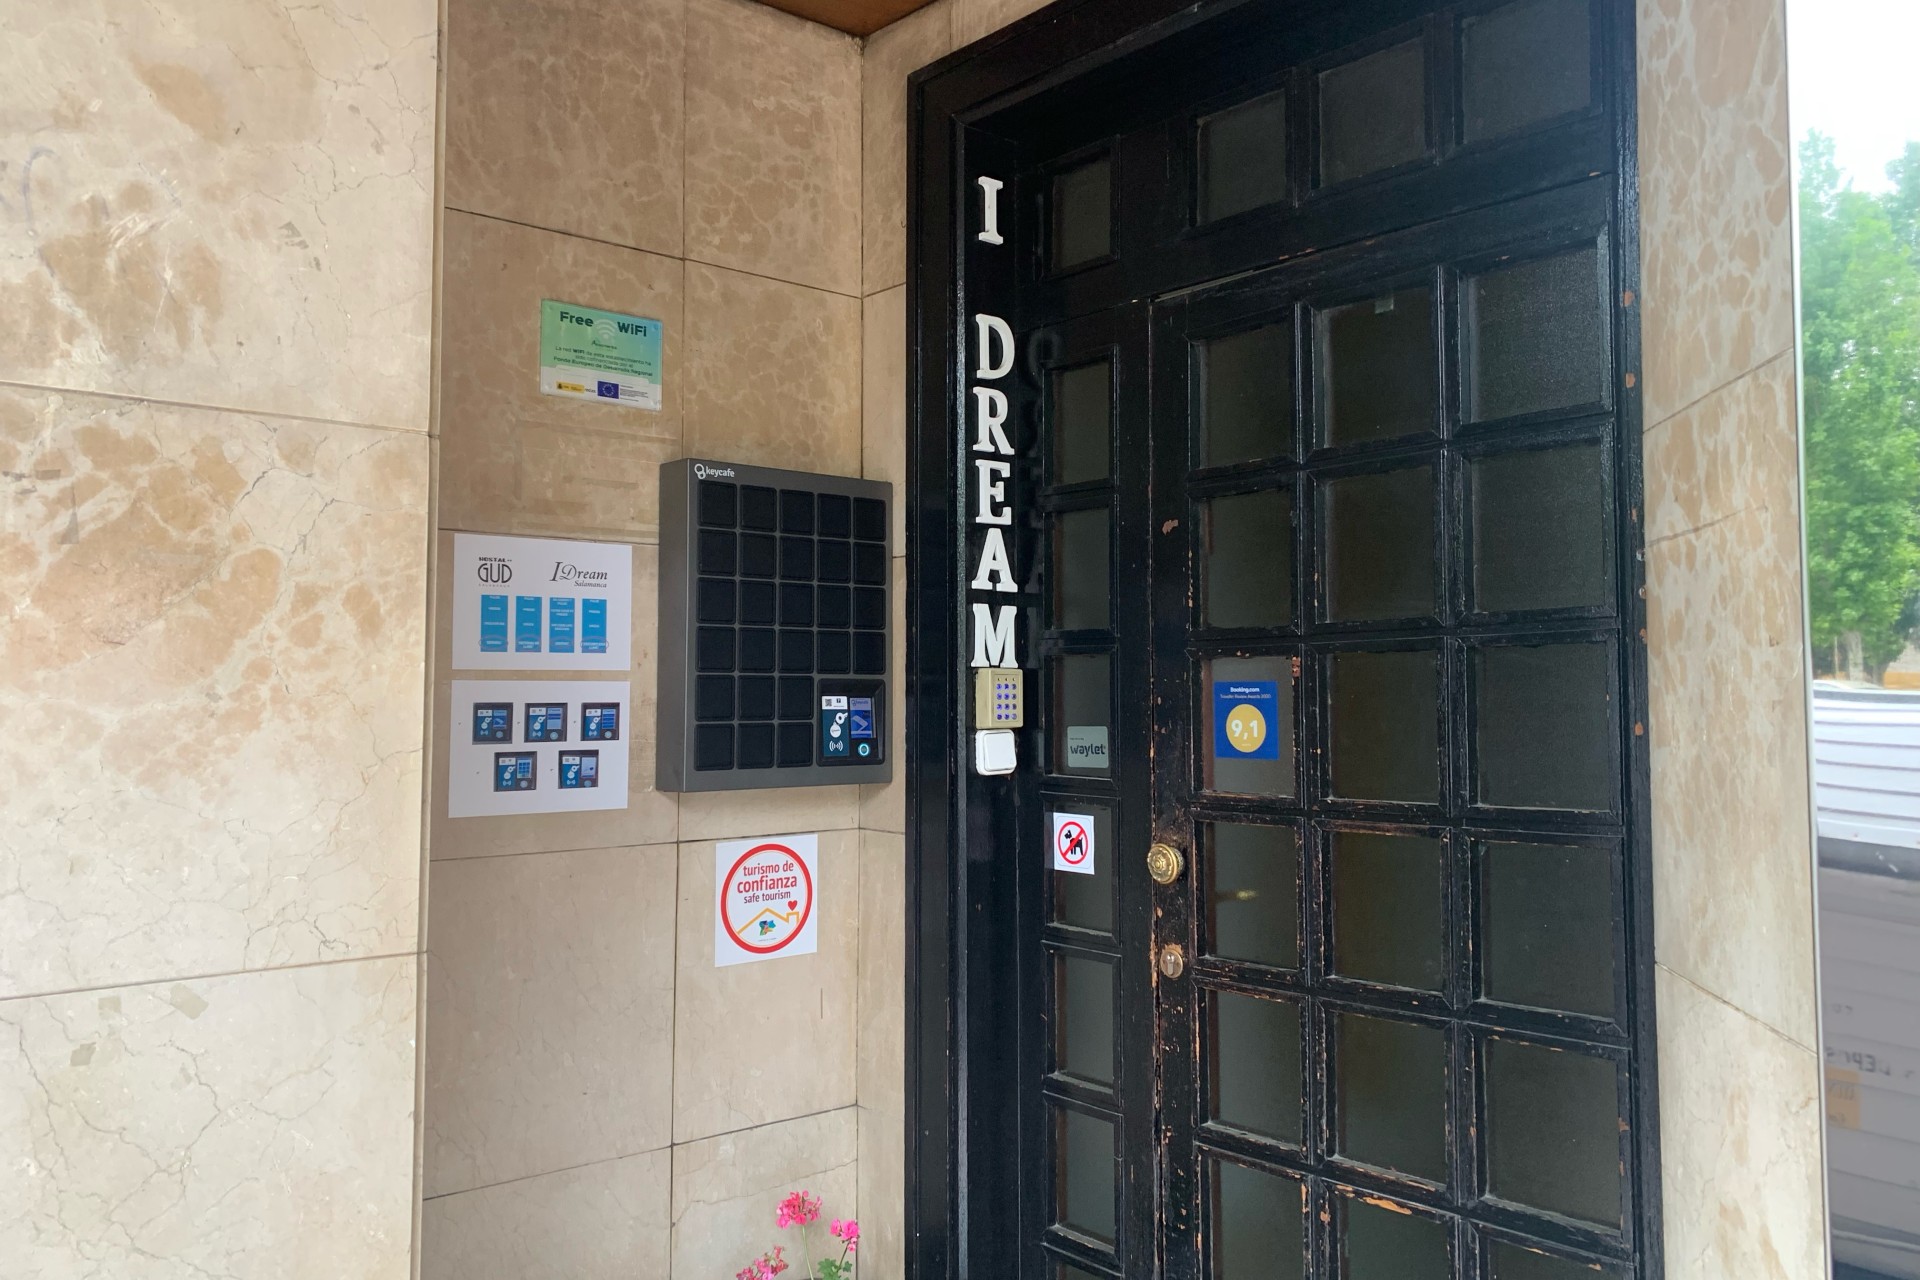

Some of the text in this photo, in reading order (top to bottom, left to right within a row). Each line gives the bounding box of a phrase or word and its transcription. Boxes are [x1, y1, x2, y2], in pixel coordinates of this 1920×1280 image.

[978, 176, 1003, 245] I
[560, 311, 647, 337] Free WiFi
[706, 466, 735, 478] keycafe
[971, 314, 1018, 668] DREAM
[478, 563, 512, 583] GUD
[561, 564, 608, 580] Dream
[574, 580, 607, 588] Salamanca
[1231, 719, 1258, 740] 9,1
[1070, 744, 1105, 757] waylet
[743, 860, 794, 876] turismo de
[737, 875, 797, 894] confianza
[744, 890, 790, 904] safe tourism
